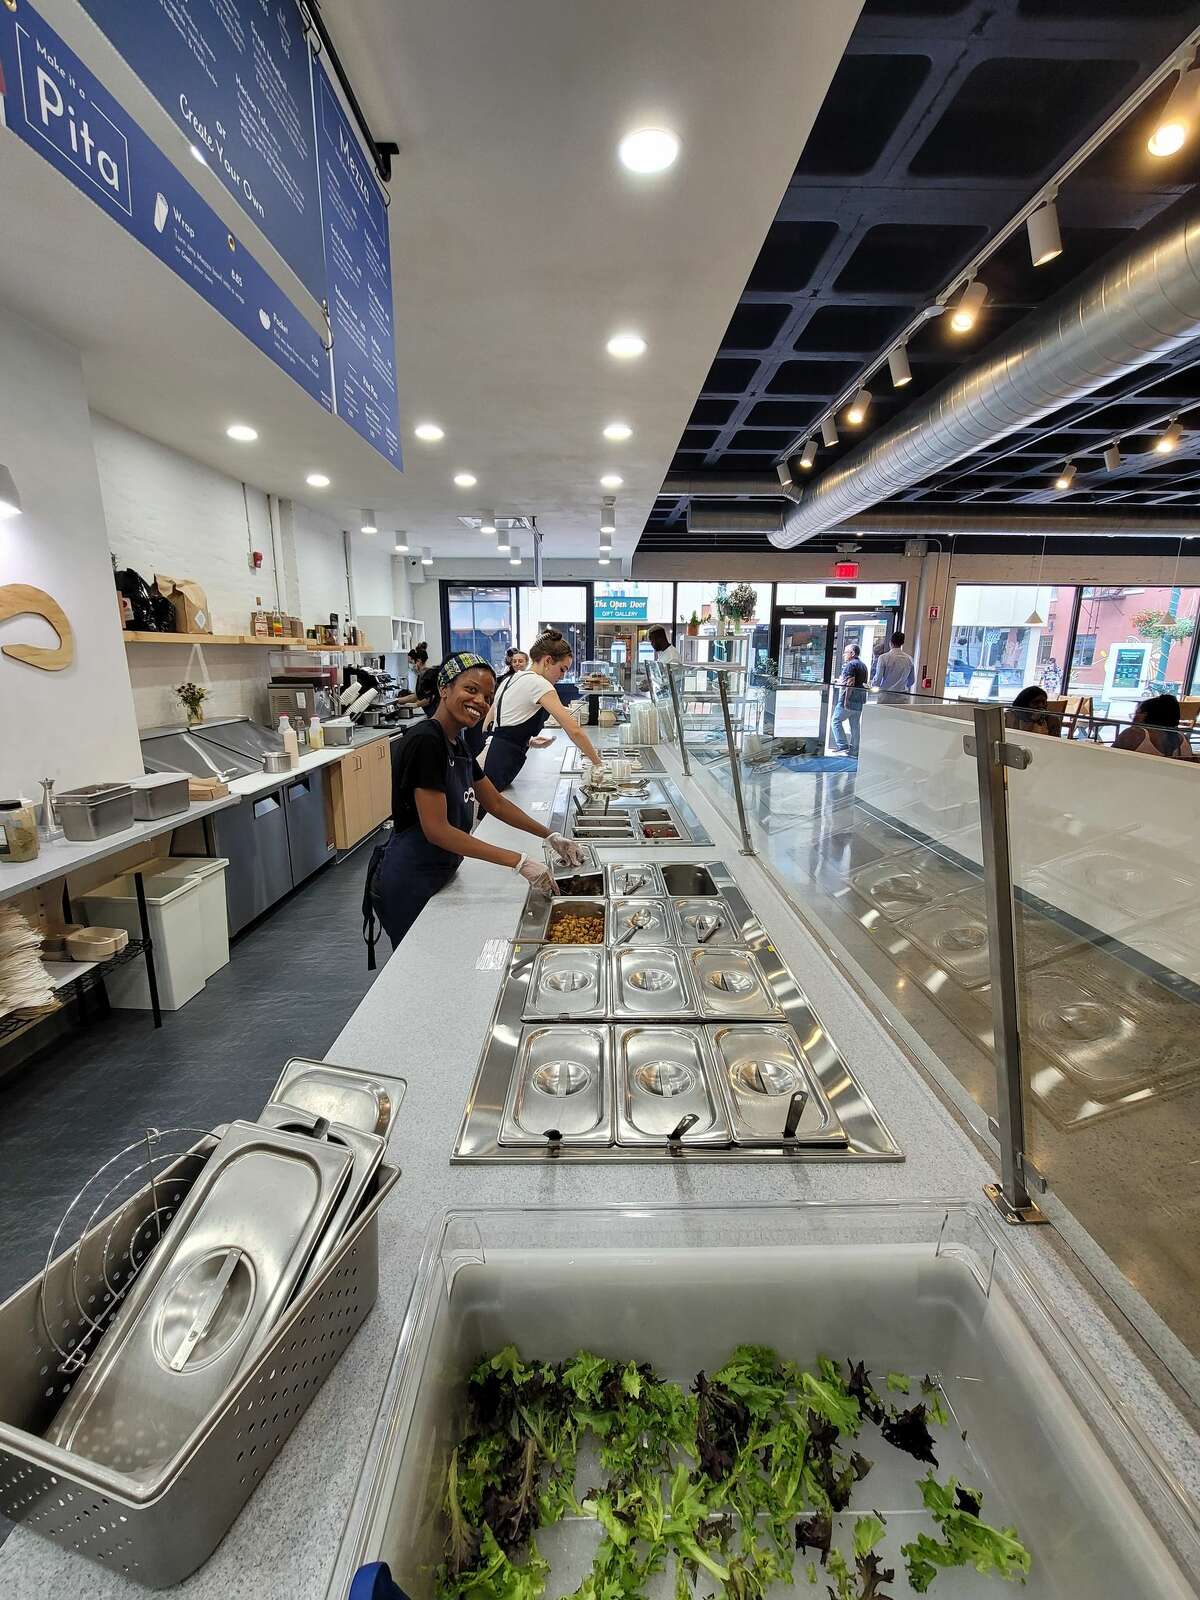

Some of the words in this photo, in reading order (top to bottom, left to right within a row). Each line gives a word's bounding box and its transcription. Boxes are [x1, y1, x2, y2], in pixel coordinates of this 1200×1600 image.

[36, 38, 66, 79] Make
[68, 73, 76, 89] it
[79, 88, 86, 100] a
[36, 65, 120, 193] Pita
[216, 120, 227, 140] or
[180, 93, 215, 153] Create
[215, 138, 240, 186] Your
[243, 179, 265, 219] Own
[173, 205, 195, 238] Wrap
[594, 599, 607, 608] The
[609, 600, 627, 610] Open
[629, 600, 647, 608] Door
